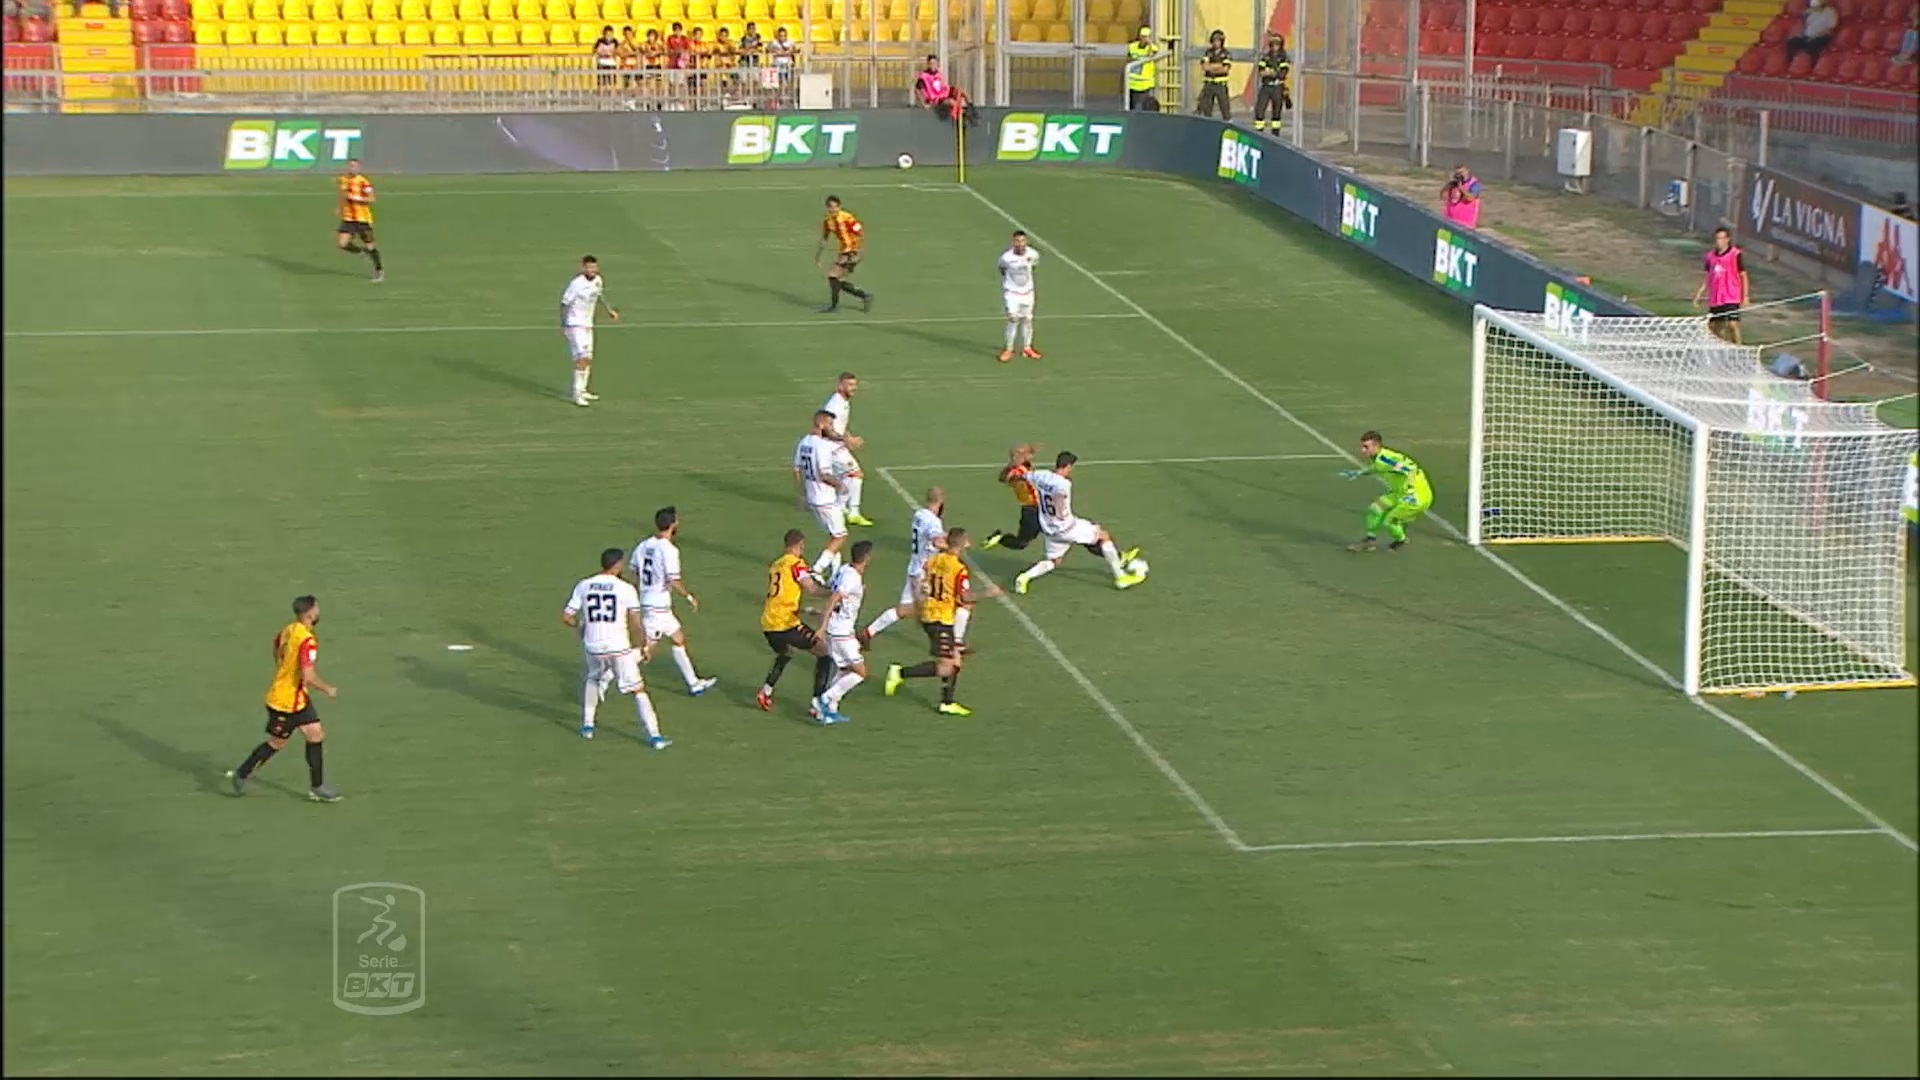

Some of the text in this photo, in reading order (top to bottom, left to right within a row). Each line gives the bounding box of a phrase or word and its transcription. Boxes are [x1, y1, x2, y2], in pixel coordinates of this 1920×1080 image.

[227, 129, 361, 160] BKT
[729, 123, 857, 155] BKT
[1001, 122, 1122, 154] BKT
[1219, 138, 1262, 179] BKT
[1342, 194, 1379, 237] BKT
[1772, 192, 1792, 227] LA
[1796, 200, 1846, 248] VIGNA
[1435, 238, 1477, 287] BKT
[1544, 291, 1594, 344] BKT
[1039, 490, 1056, 516] 16
[586, 593, 617, 623] 23
